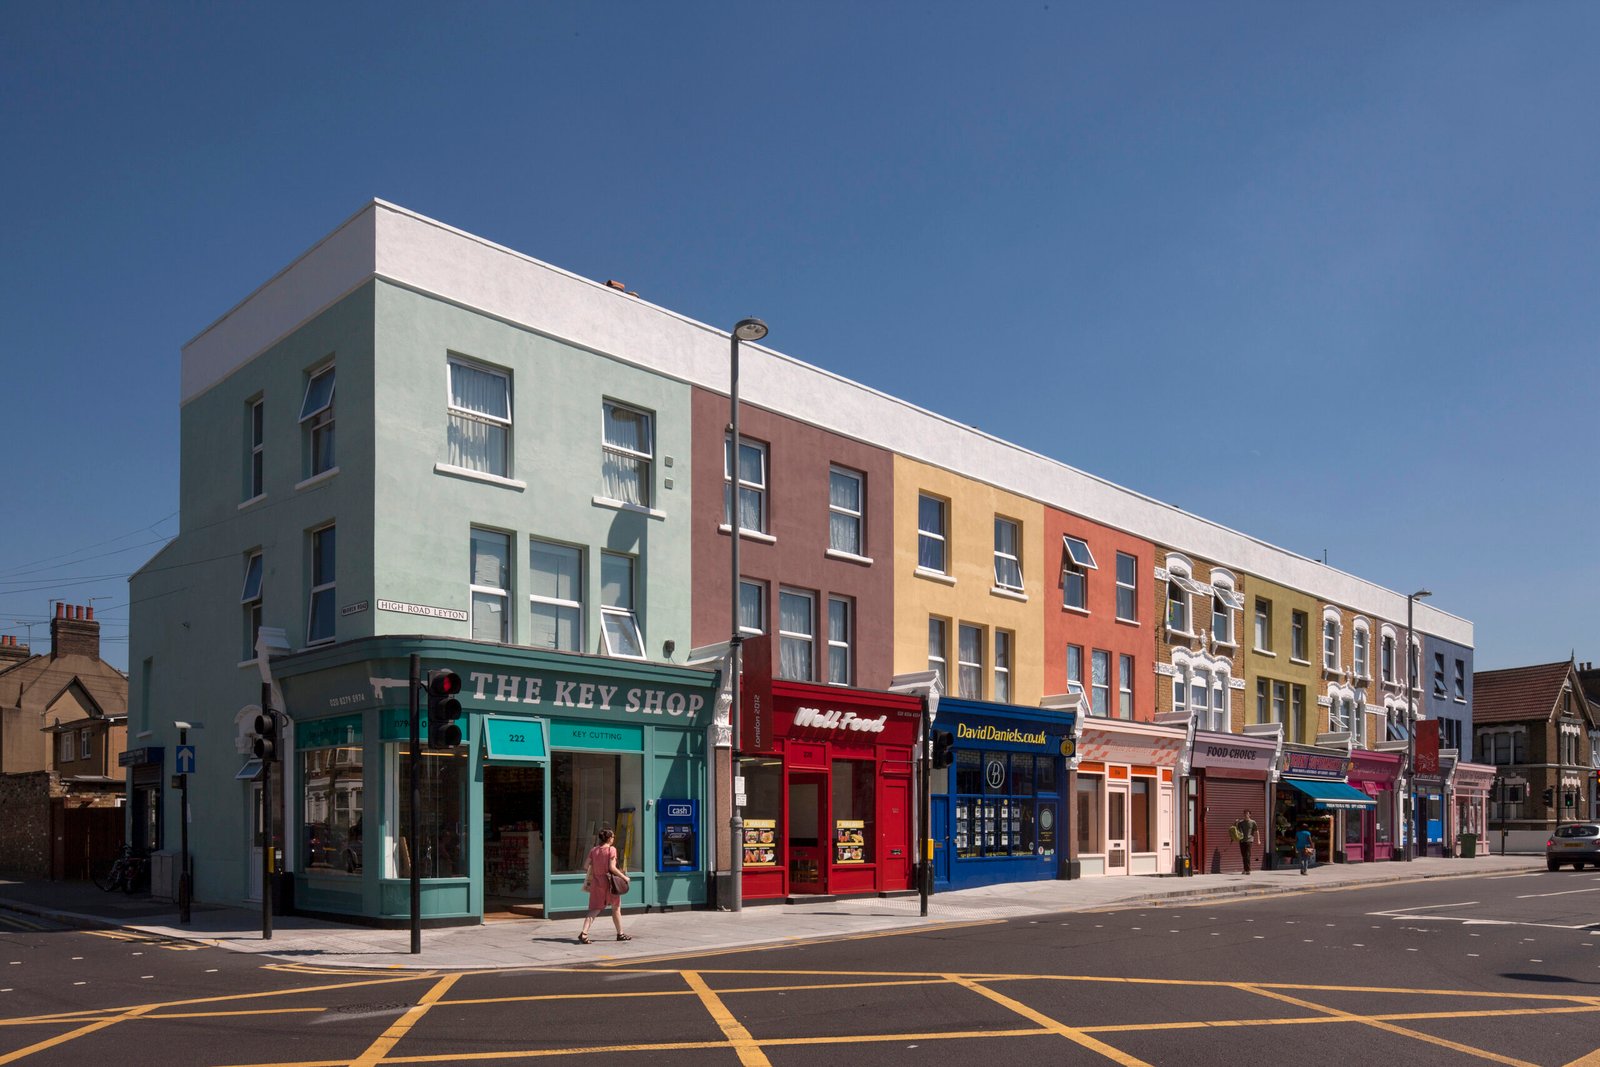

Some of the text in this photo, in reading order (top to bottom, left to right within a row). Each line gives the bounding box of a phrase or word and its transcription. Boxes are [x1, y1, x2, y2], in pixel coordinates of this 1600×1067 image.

[381, 601, 465, 619] HIGH ROAD LEYTON
[470, 671, 704, 718] THE KEY SHOP
[753, 694, 761, 748] London 2012
[793, 706, 887, 733] Well Food
[509, 734, 525, 743] 222
[572, 730, 622, 741] KEY CUTTING
[1206, 746, 1257, 761] FOOD CHOICE
[672, 806, 688, 815] cash
